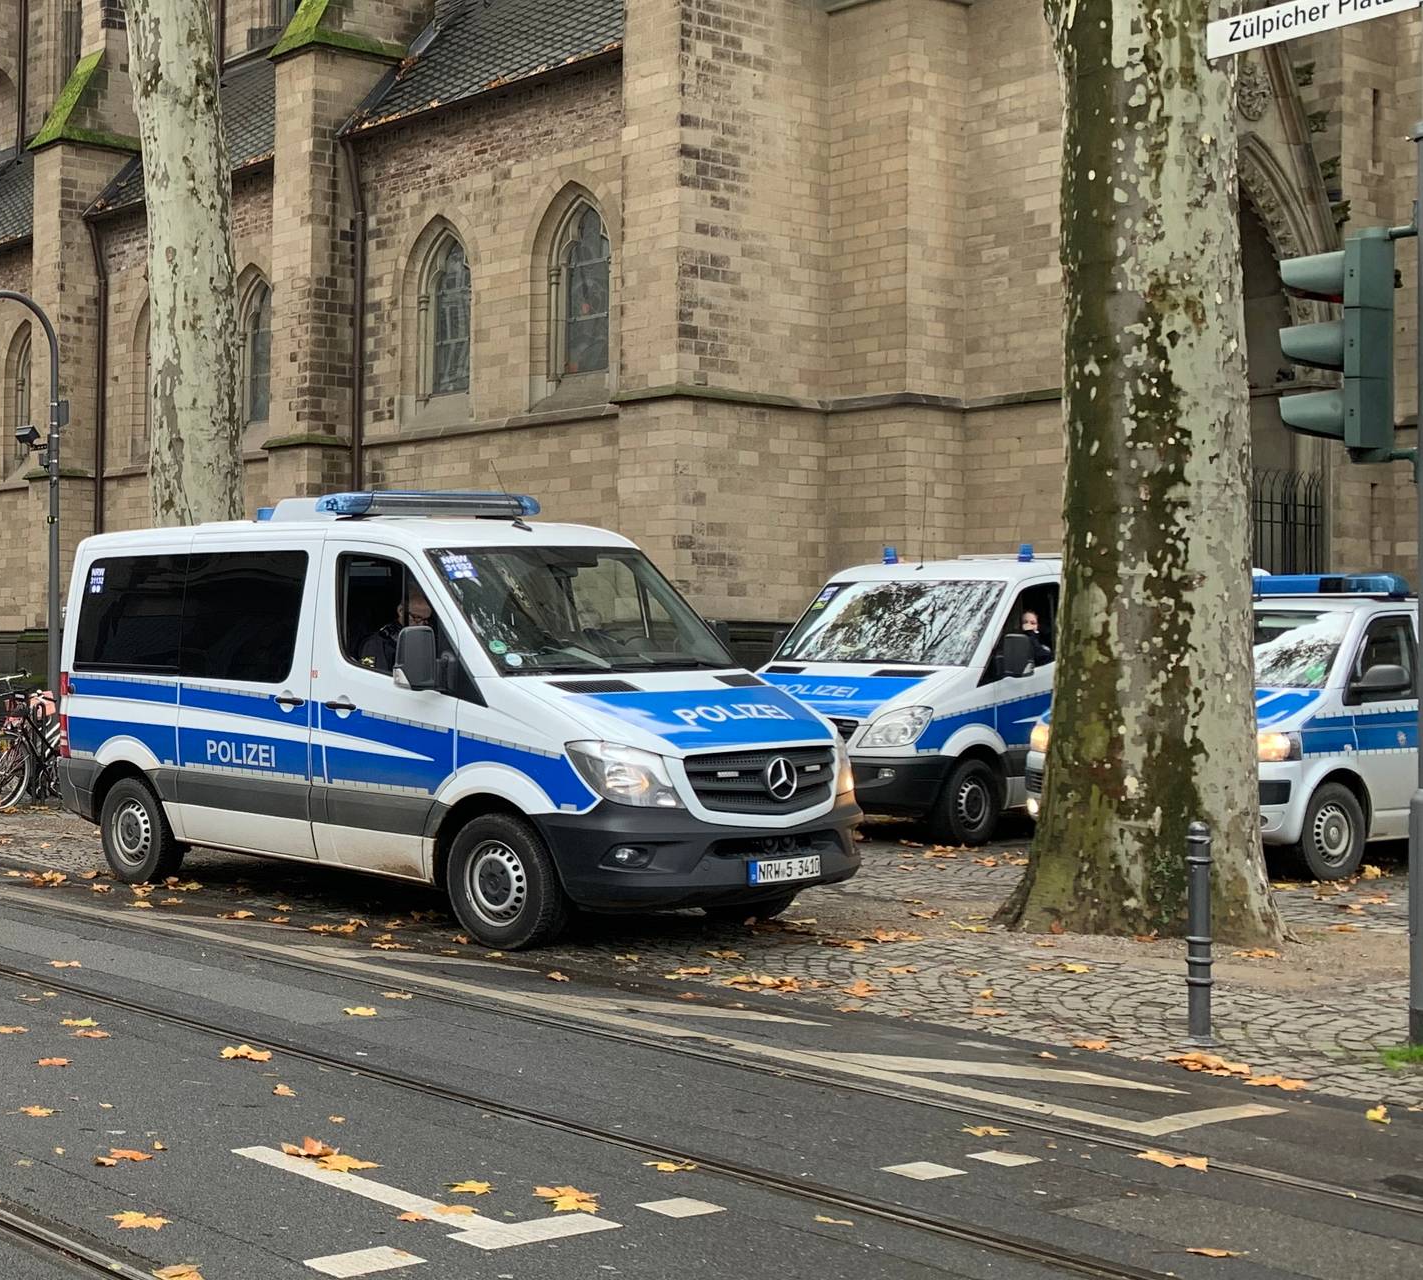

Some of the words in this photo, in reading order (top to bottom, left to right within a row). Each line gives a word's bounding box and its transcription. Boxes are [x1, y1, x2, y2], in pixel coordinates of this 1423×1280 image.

[1229, 3, 1330, 42] Zülpicher
[1338, 0, 1393, 14] Pla
[672, 703, 795, 726] POLIZEI
[206, 739, 276, 768] POLIZEI
[759, 863, 781, 880] NRW
